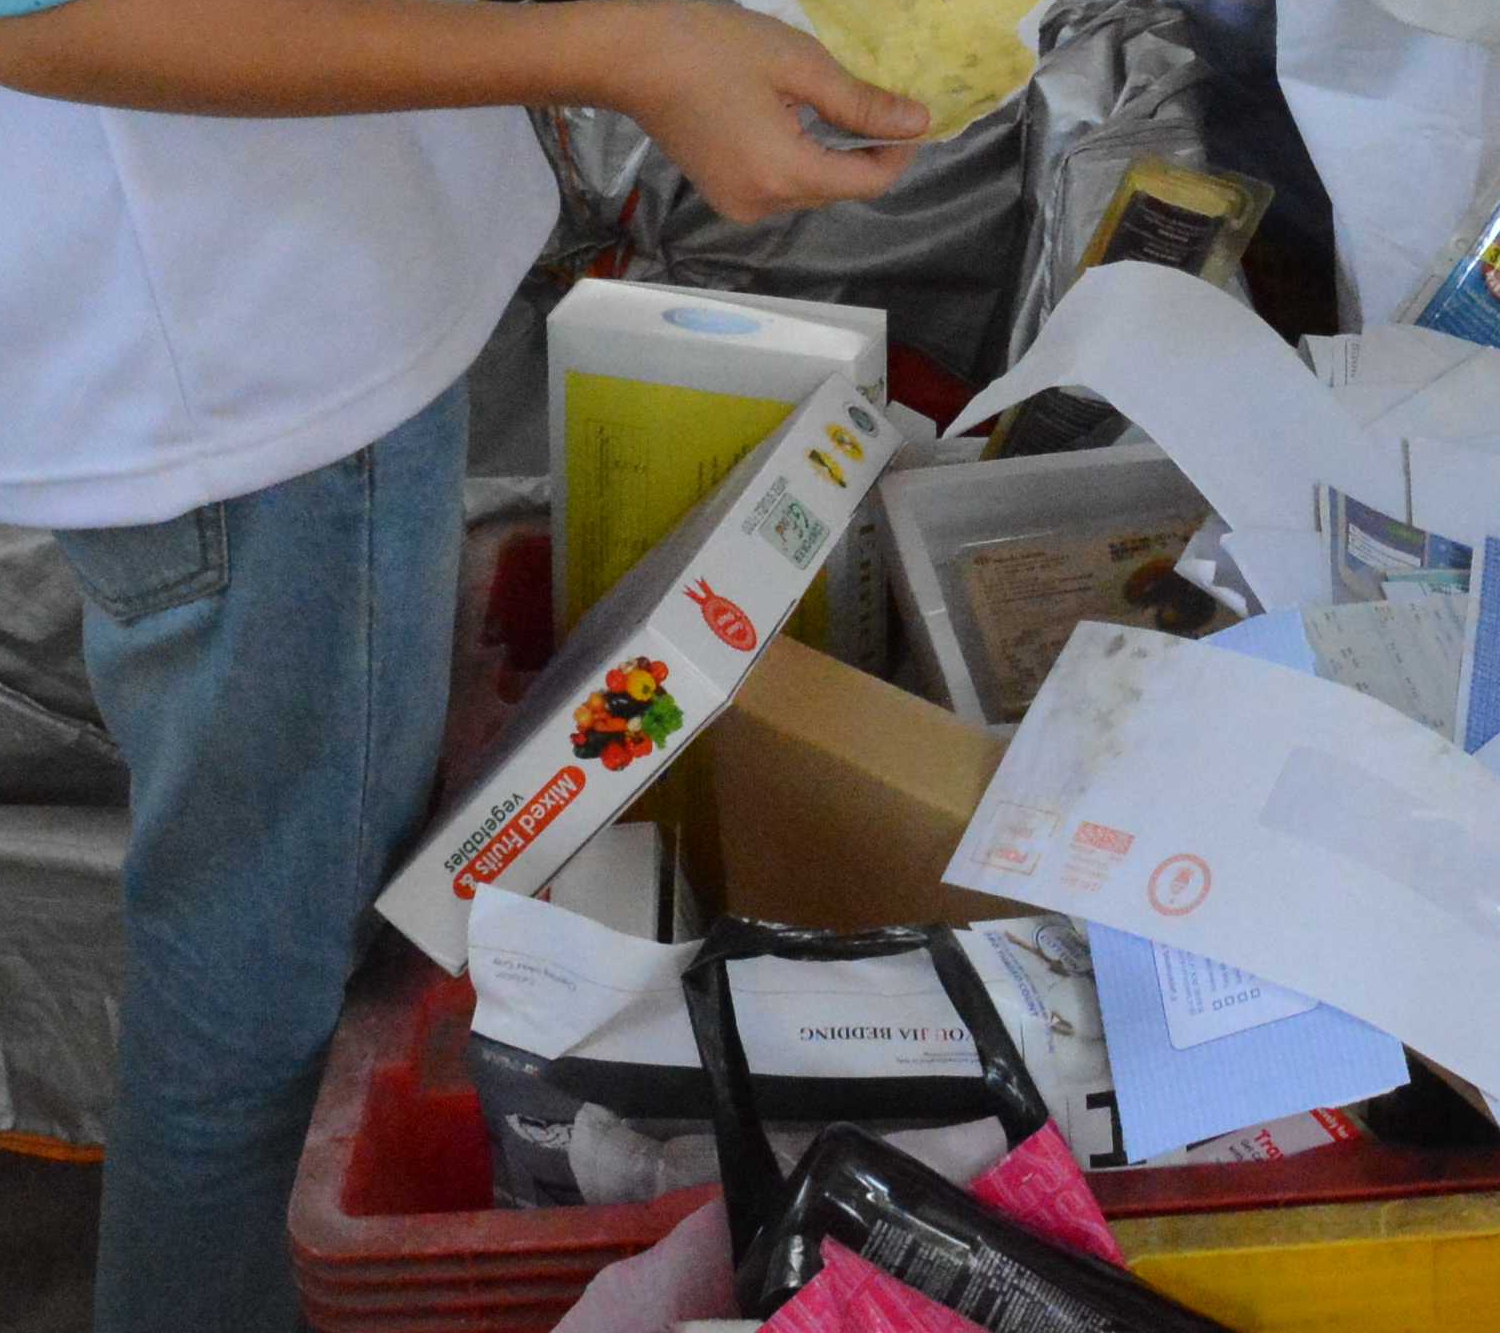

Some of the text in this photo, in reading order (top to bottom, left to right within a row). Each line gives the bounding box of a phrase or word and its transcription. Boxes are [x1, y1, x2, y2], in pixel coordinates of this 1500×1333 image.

[443, 790, 526, 875] vegetables
[516, 773, 578, 835] Mixed
[472, 827, 525, 880] Fruits
[799, 1026, 891, 1041] BEDDING
